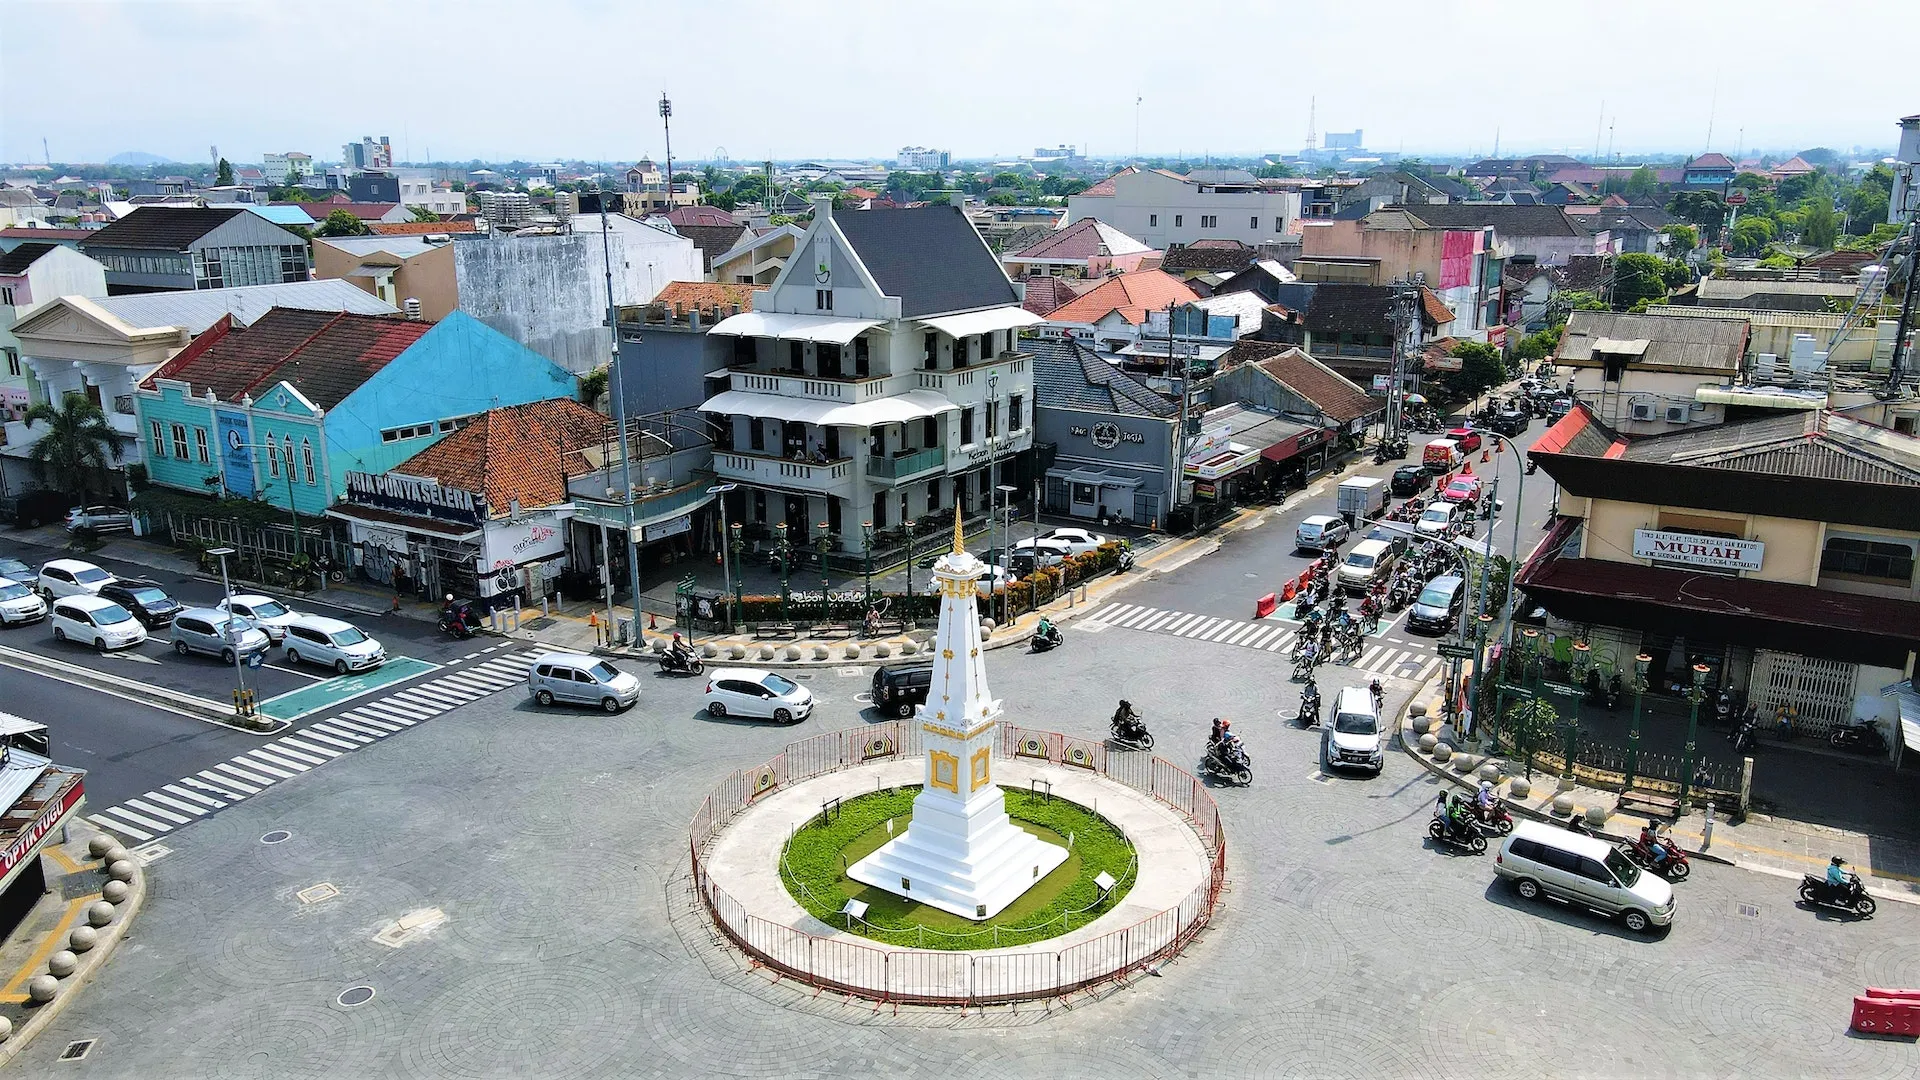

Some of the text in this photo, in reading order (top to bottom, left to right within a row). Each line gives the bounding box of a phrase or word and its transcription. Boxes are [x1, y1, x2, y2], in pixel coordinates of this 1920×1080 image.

[344, 470, 475, 512] PRIA PUNYA SELERA
[1653, 539, 1741, 560] MURAH
[4, 828, 39, 870] OPTIK
[36, 799, 64, 836] TUGU
